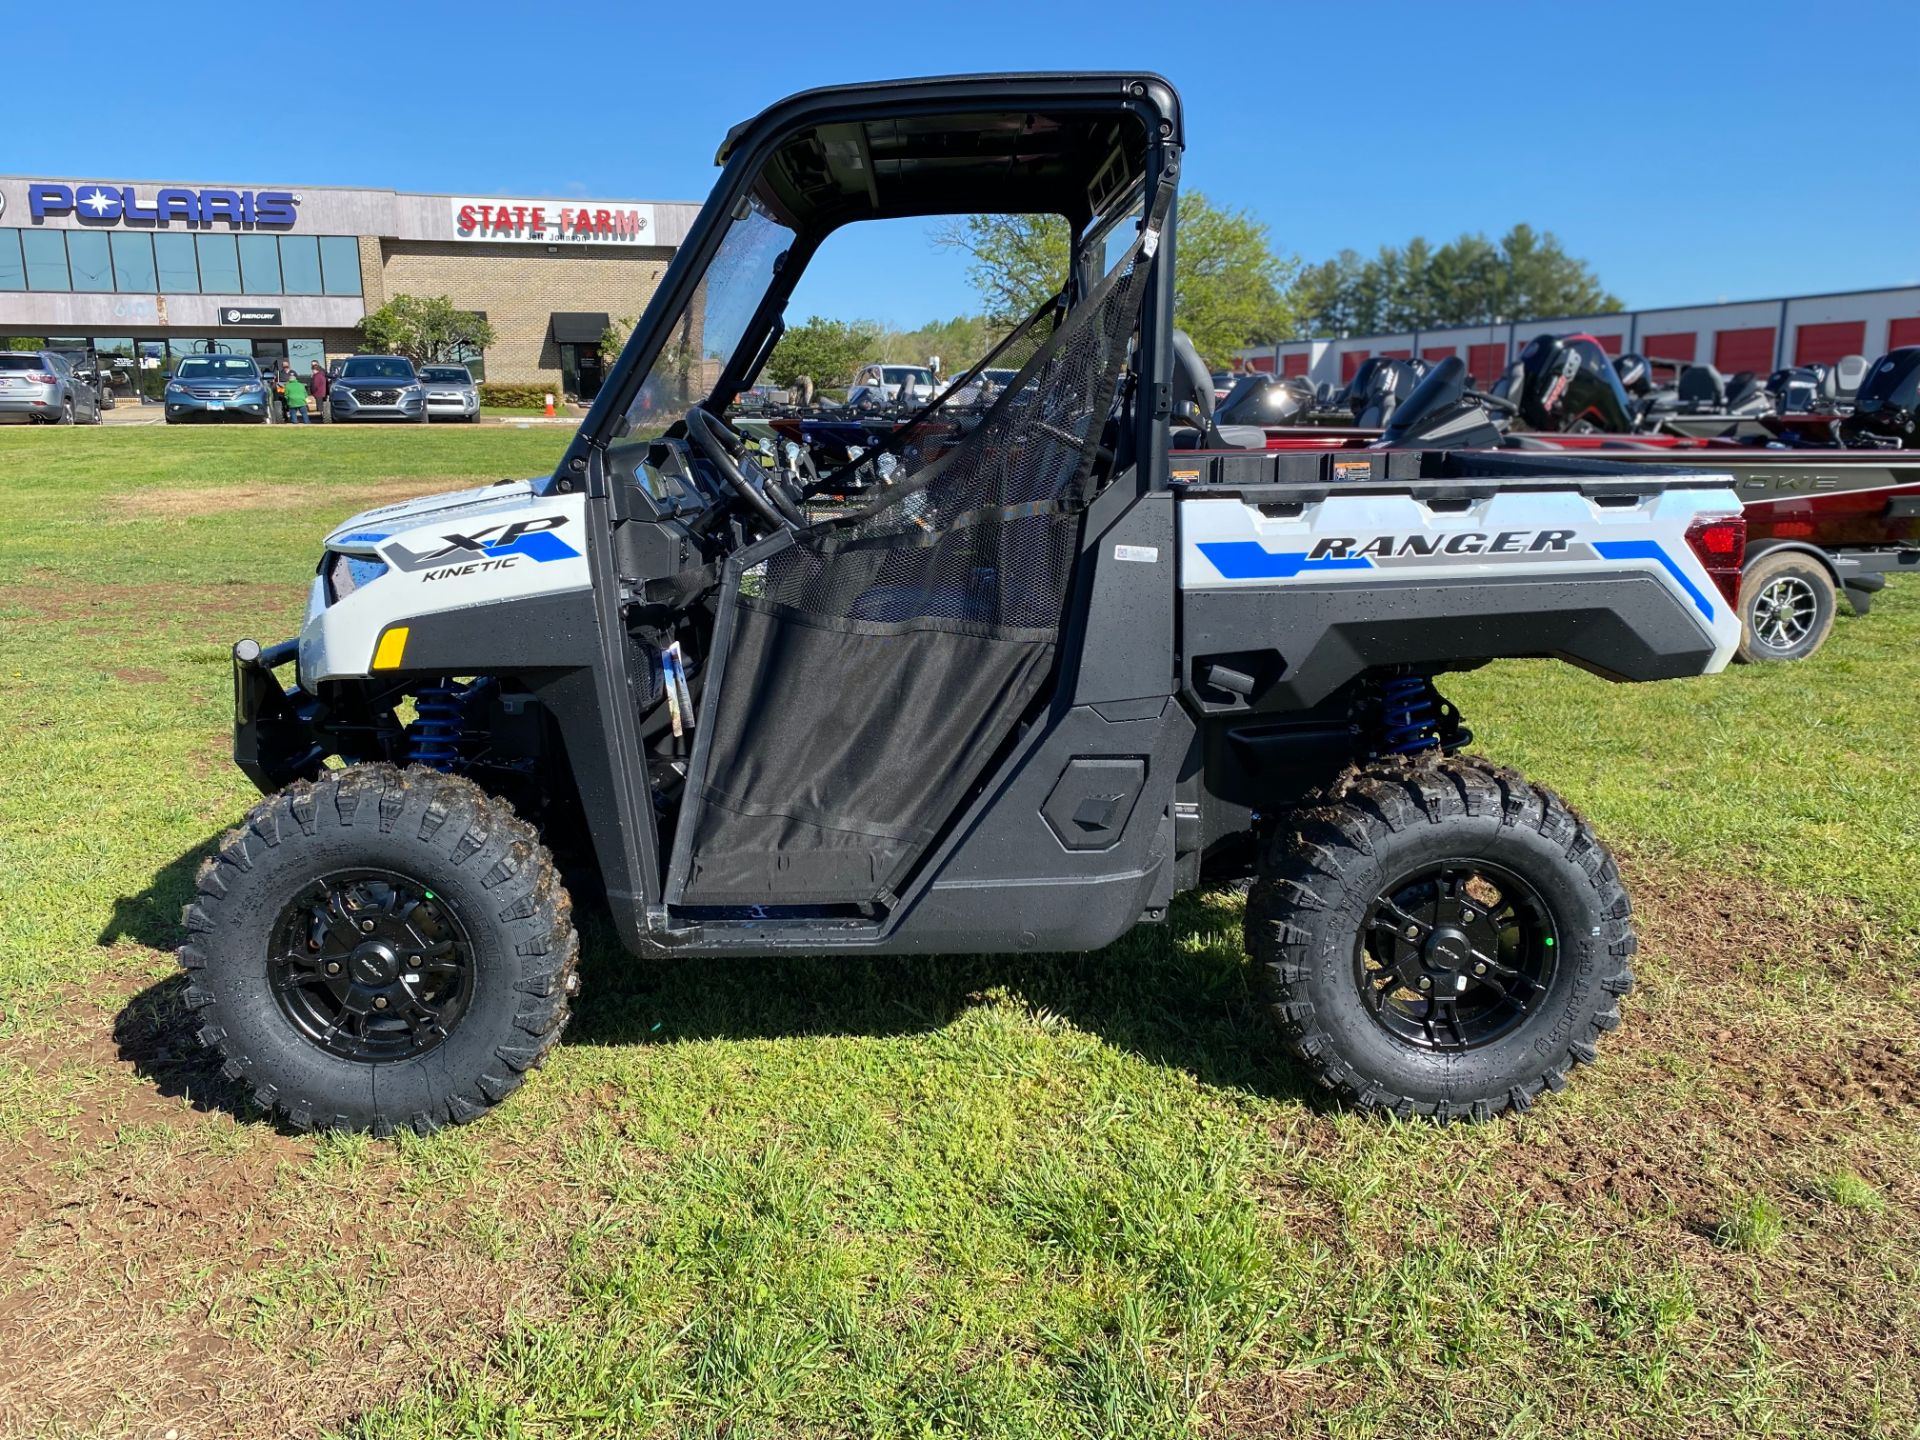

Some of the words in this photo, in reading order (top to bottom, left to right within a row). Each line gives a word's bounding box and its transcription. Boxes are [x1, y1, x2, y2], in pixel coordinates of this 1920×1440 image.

[28, 183, 297, 225] POLARIS
[460, 205, 547, 232] STATE
[561, 207, 640, 235] FARM
[419, 514, 571, 562] XP
[420, 514, 570, 561] RANGER
[421, 556, 520, 583] KINETIC
